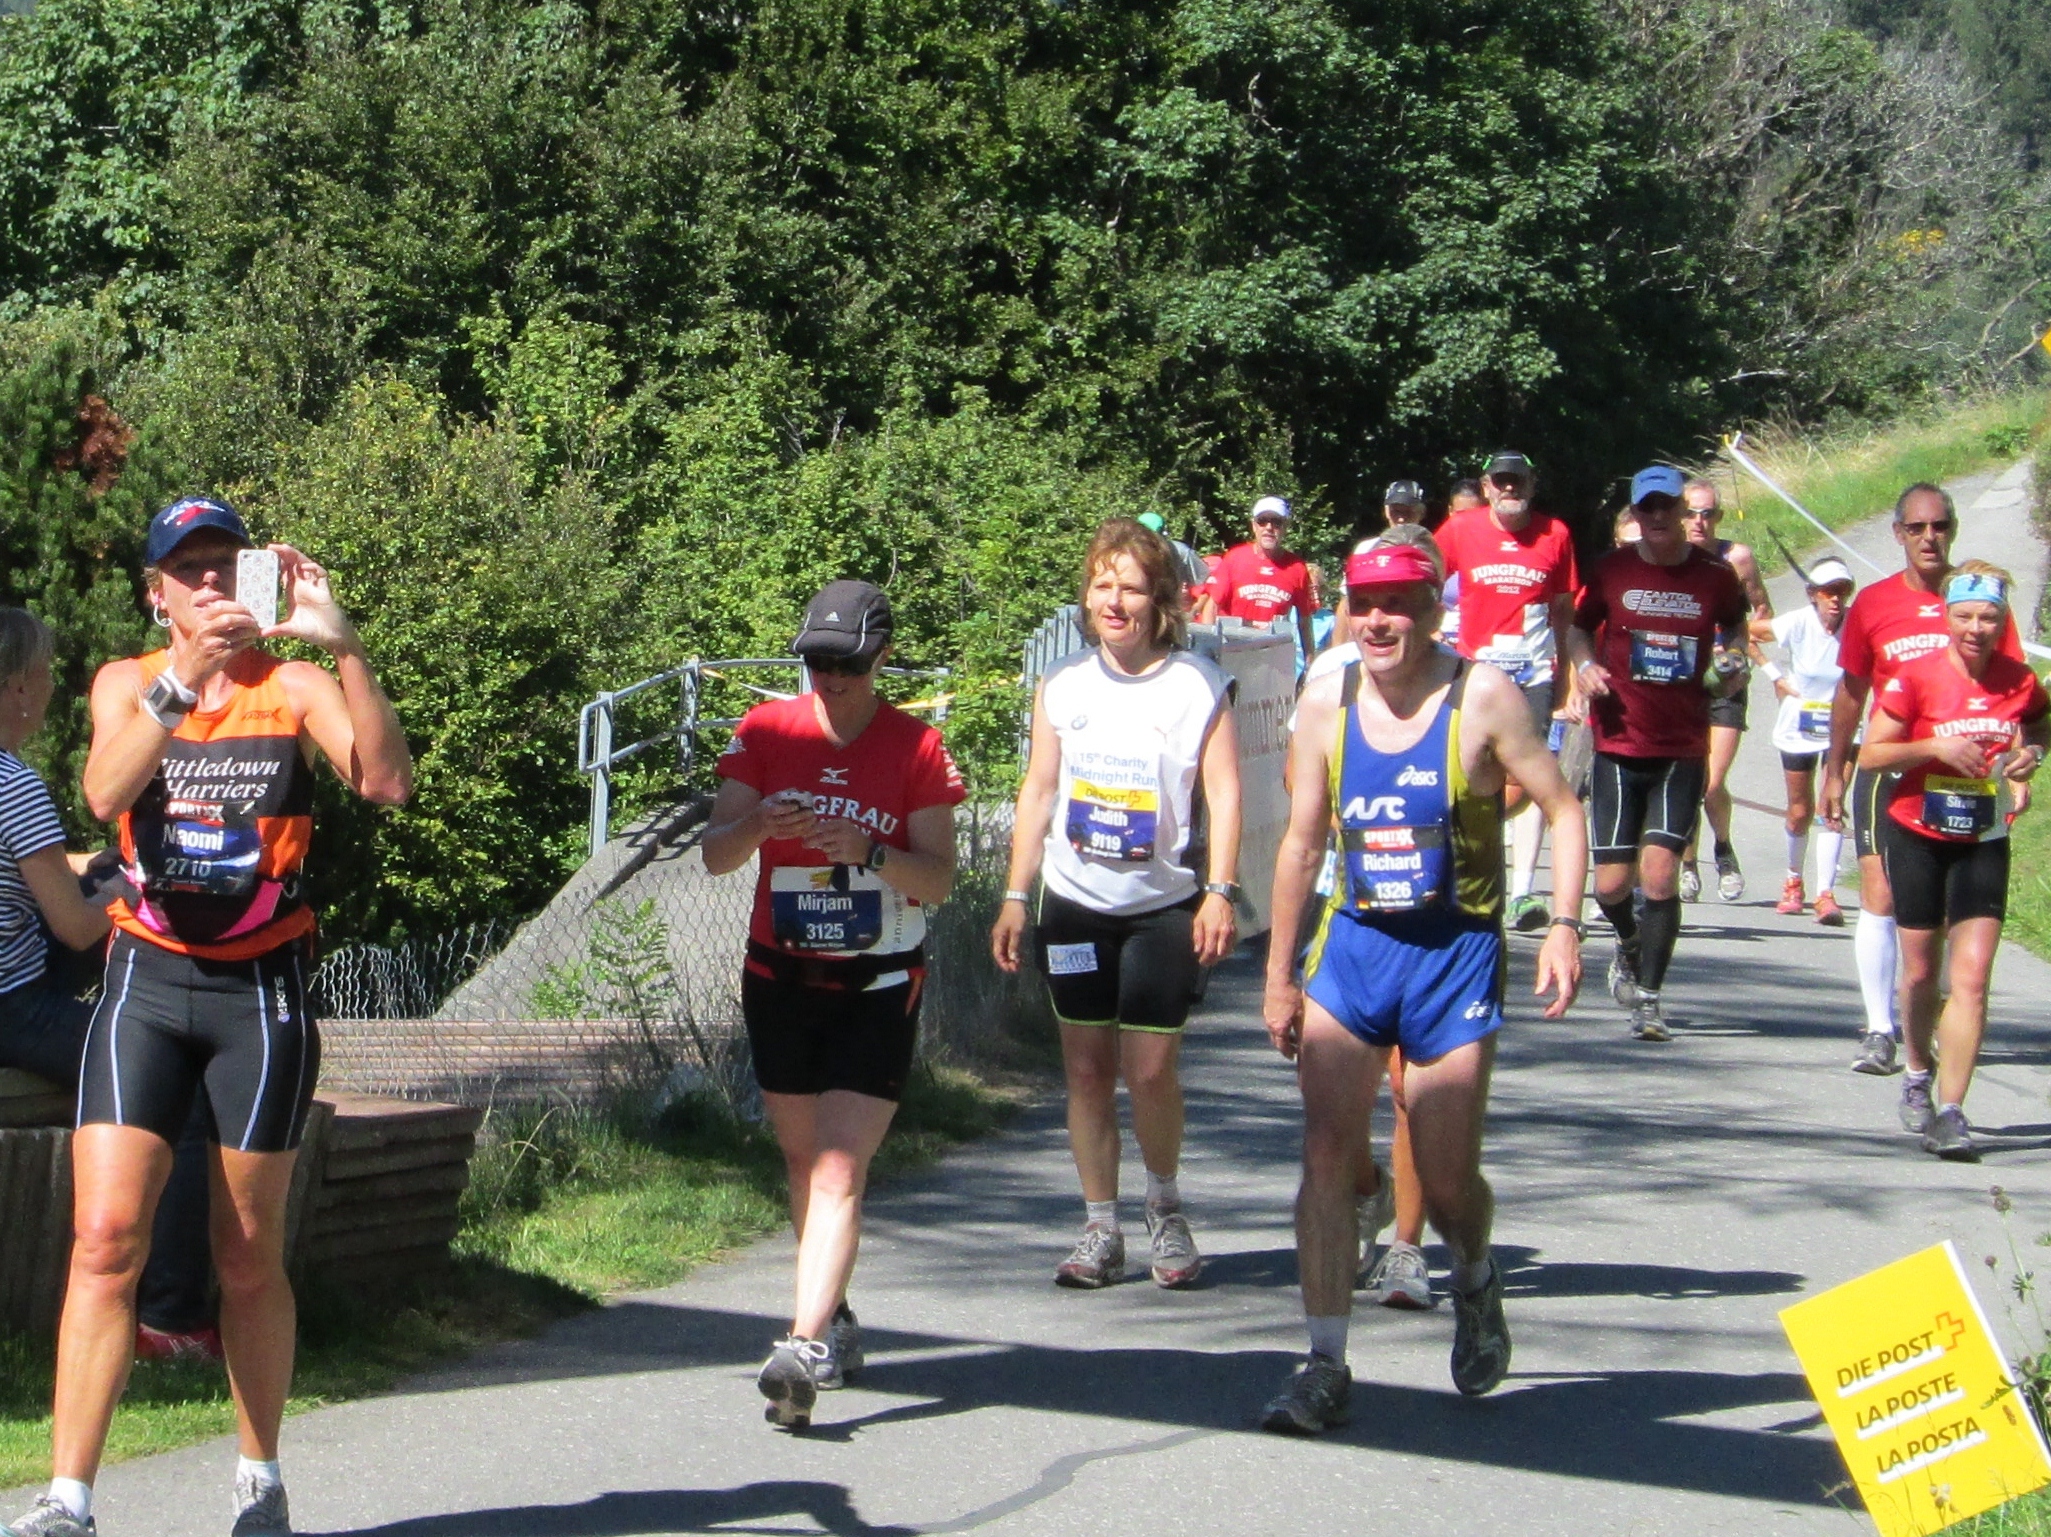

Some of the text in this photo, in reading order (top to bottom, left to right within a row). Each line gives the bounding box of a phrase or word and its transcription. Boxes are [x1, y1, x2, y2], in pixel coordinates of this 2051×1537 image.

[1643, 647, 1679, 661] Robert
[1883, 633, 1951, 662] JUNGFR
[1647, 664, 1672, 678] 3414
[160, 756, 281, 778] ittledown
[1103, 755, 1149, 772] Charity
[1070, 765, 1160, 788] Midnight Run
[1089, 805, 1129, 827] Judith
[1947, 815, 1974, 829] 1723
[163, 825, 225, 852] Naomi
[1091, 831, 1122, 852] 9119
[165, 857, 213, 877] 2710
[1362, 852, 1422, 872] Richard
[1374, 881, 1413, 899] 1326
[798, 893, 853, 915] Mirjam
[806, 922, 845, 941] 3125
[1836, 1331, 1935, 1391] DIE POST
[1855, 1372, 1957, 1431] LA POSTE
[1876, 1416, 1982, 1475] LA POSTA
